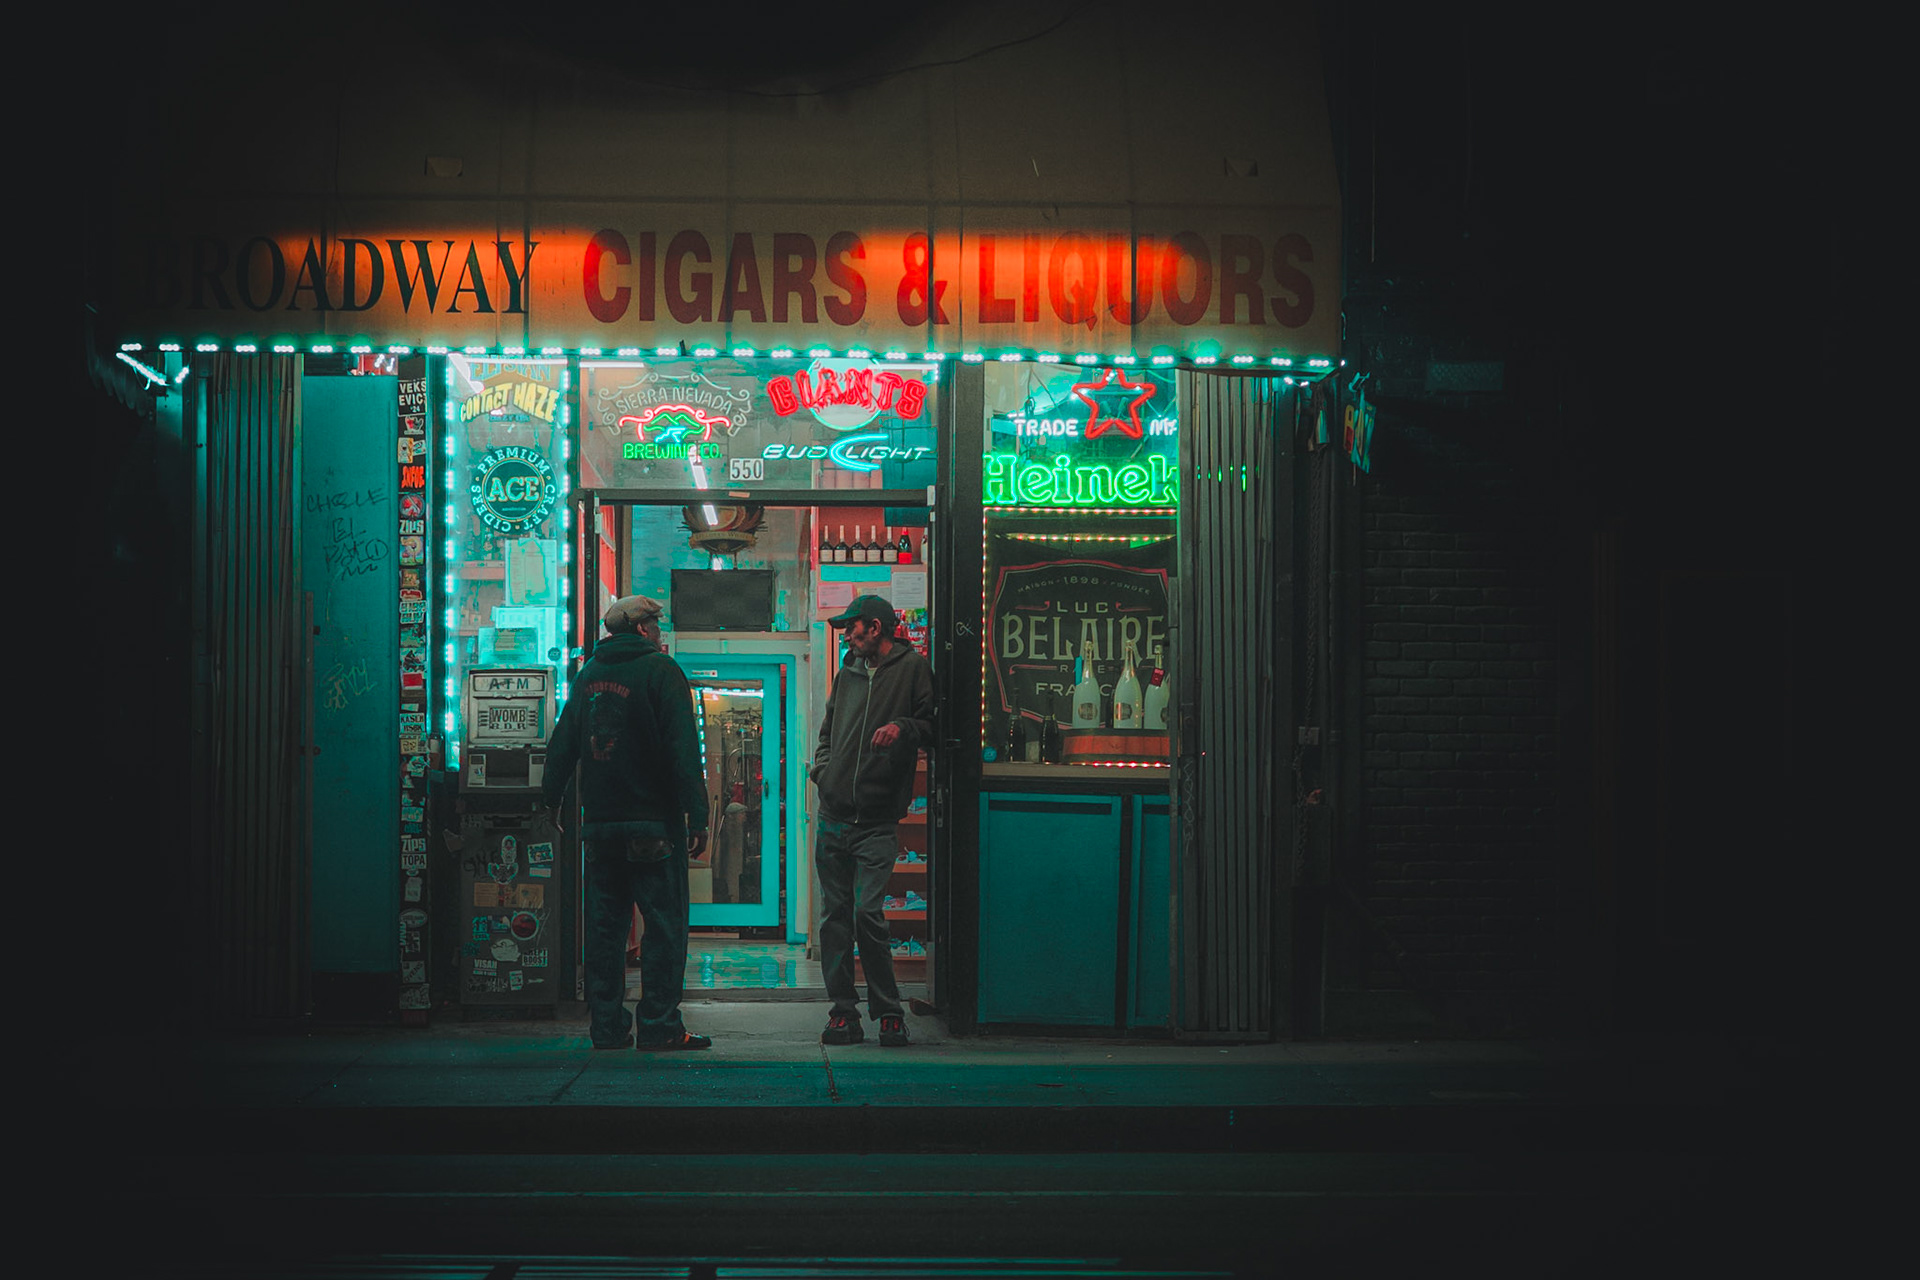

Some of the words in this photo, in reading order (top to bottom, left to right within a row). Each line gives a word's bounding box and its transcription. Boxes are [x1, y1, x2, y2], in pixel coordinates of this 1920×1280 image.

[144, 234, 541, 314] BROADWAY
[583, 228, 868, 327] CIGARS
[896, 231, 951, 327] &
[978, 230, 1315, 332] LIQUORS
[399, 381, 426, 393] VEKS
[767, 367, 928, 420] GIANTS
[399, 393, 427, 406] EVIC
[461, 382, 513, 423] CONTACT
[514, 381, 560, 423] HAZE
[615, 387, 668, 415] SIERRA
[672, 386, 733, 416] NEVADA
[1014, 418, 1079, 436] TRADE
[476, 447, 550, 475] PREMIUM
[763, 443, 828, 459] BUD
[845, 446, 930, 460] LIGHT
[731, 459, 762, 479] 550
[488, 476, 541, 502] ACE
[471, 484, 512, 533] CIDERS
[523, 484, 556, 531] CRAFT
[1017, 579, 1055, 594] MAISON
[1063, 575, 1100, 586] 1898
[1056, 601, 1109, 613] LUC
[1001, 611, 1166, 667] BELAIRE
[1060, 665, 1105, 674] RE
[489, 678, 529, 690] ATM
[1035, 683, 1114, 697] FRAC
[491, 709, 526, 723] WOMB
